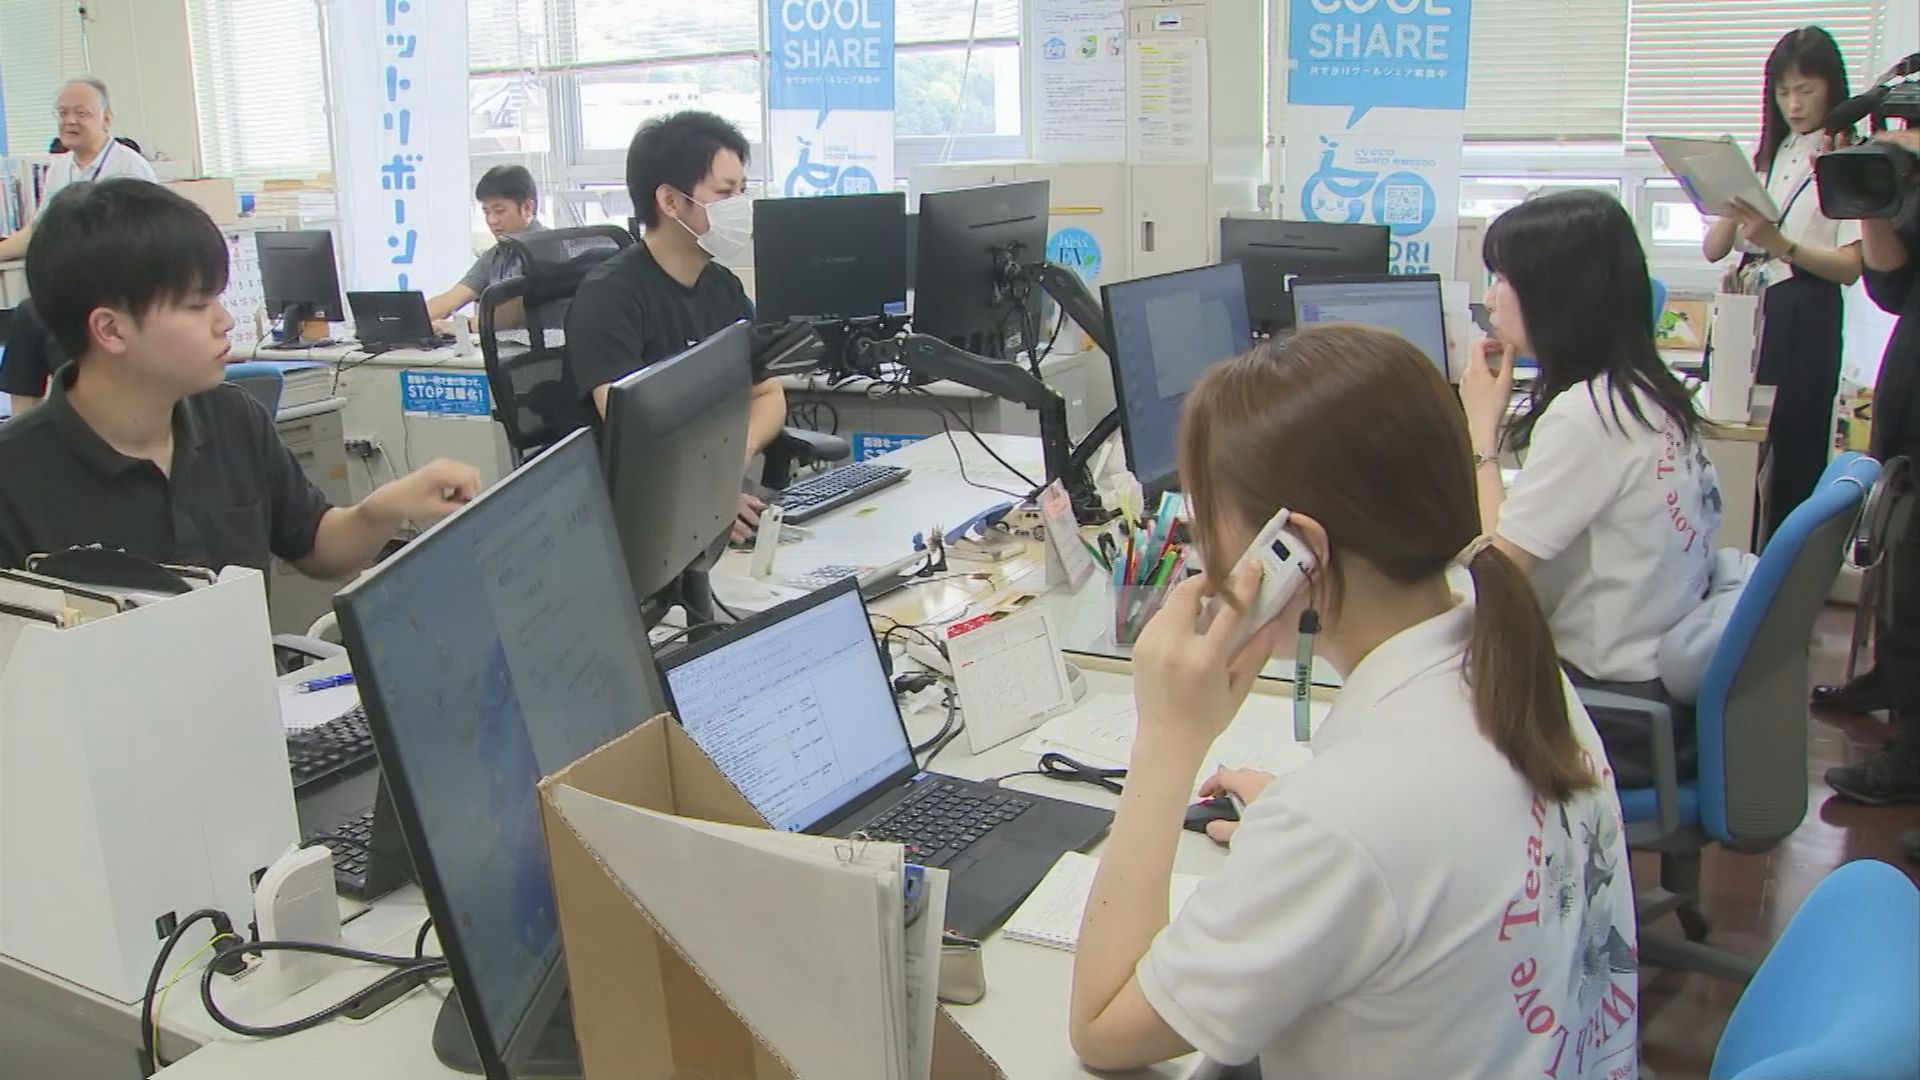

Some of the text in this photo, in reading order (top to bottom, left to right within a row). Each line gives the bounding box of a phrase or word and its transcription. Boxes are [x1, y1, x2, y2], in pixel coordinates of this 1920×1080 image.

[782, 0, 881, 32] COOL
[783, 37, 881, 69] SHARE
[1309, 23, 1450, 60] SHARE
[1666, 488, 1697, 552] Love
[1510, 957, 1570, 1079] Love
